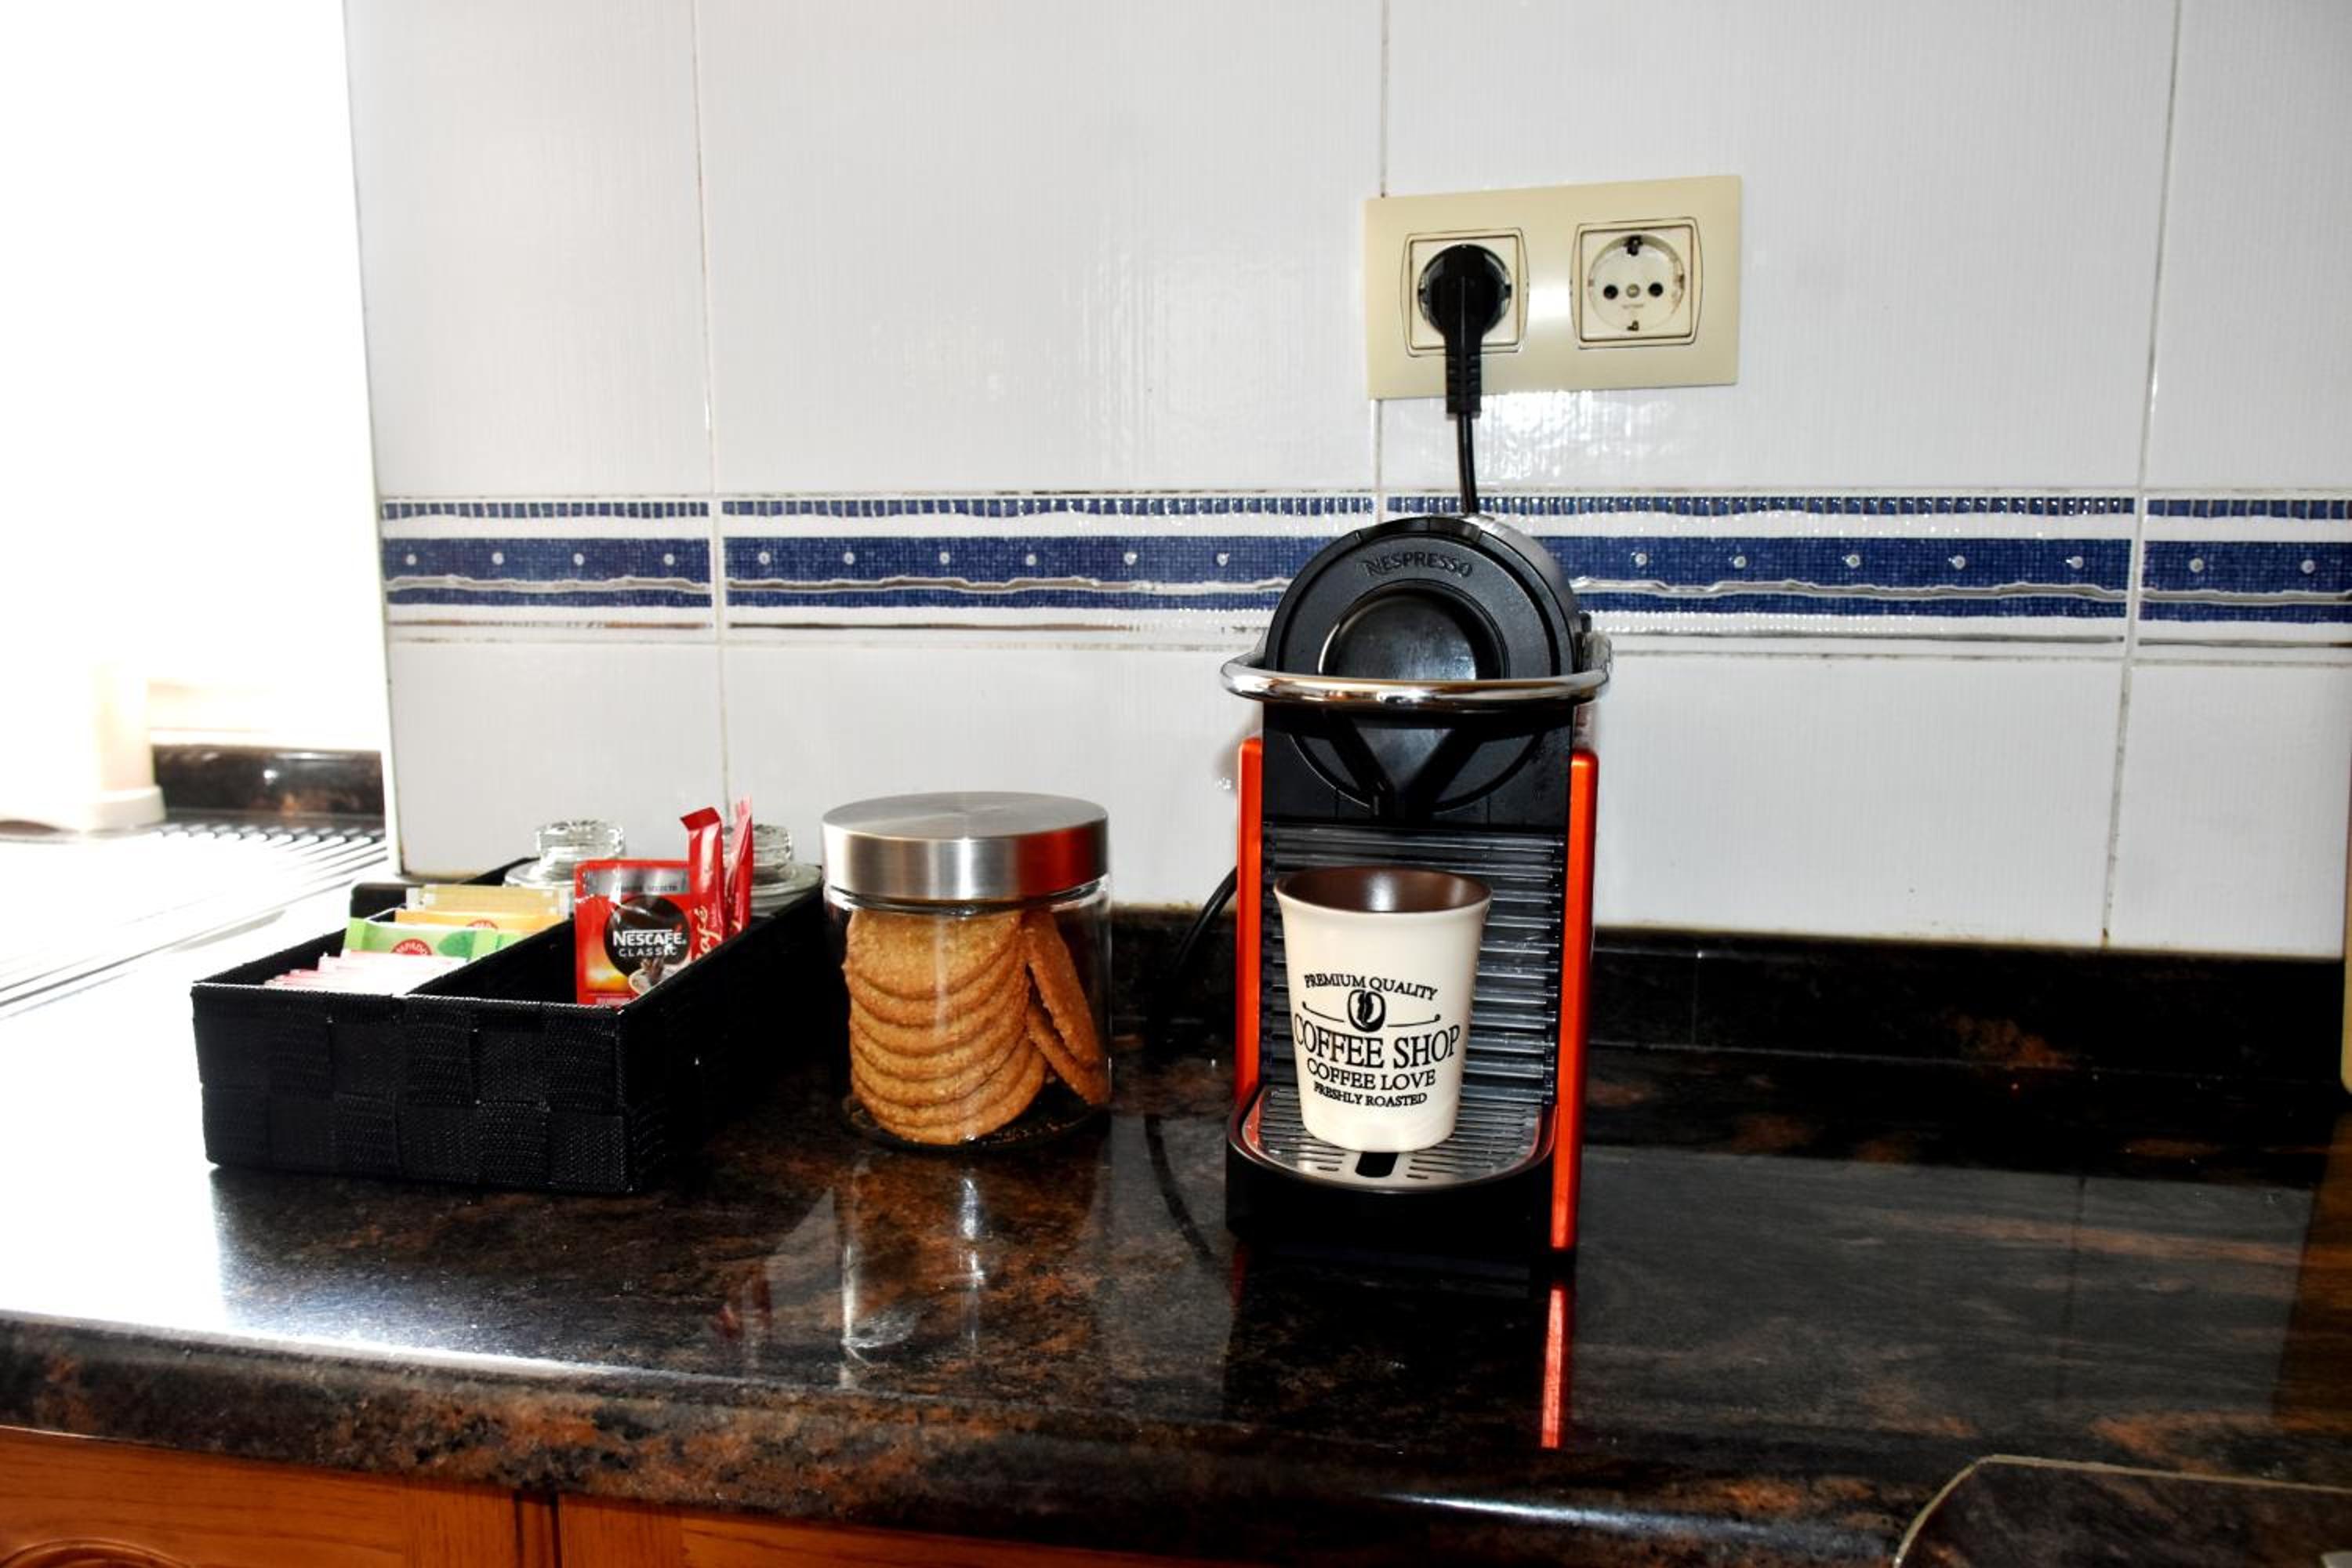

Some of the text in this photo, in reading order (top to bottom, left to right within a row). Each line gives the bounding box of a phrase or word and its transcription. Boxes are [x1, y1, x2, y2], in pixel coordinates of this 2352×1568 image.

[1356, 551, 1473, 578] NESPRESSO
[619, 947, 677, 957] CLASSIC
[1304, 973, 1439, 1001] PREMIUM QUALITY
[1294, 1014, 1460, 1069] COFFEE SHOP
[1306, 1058, 1436, 1091] COFFEE LOVE
[1313, 1080, 1428, 1108] FRESHLY ROASTED
